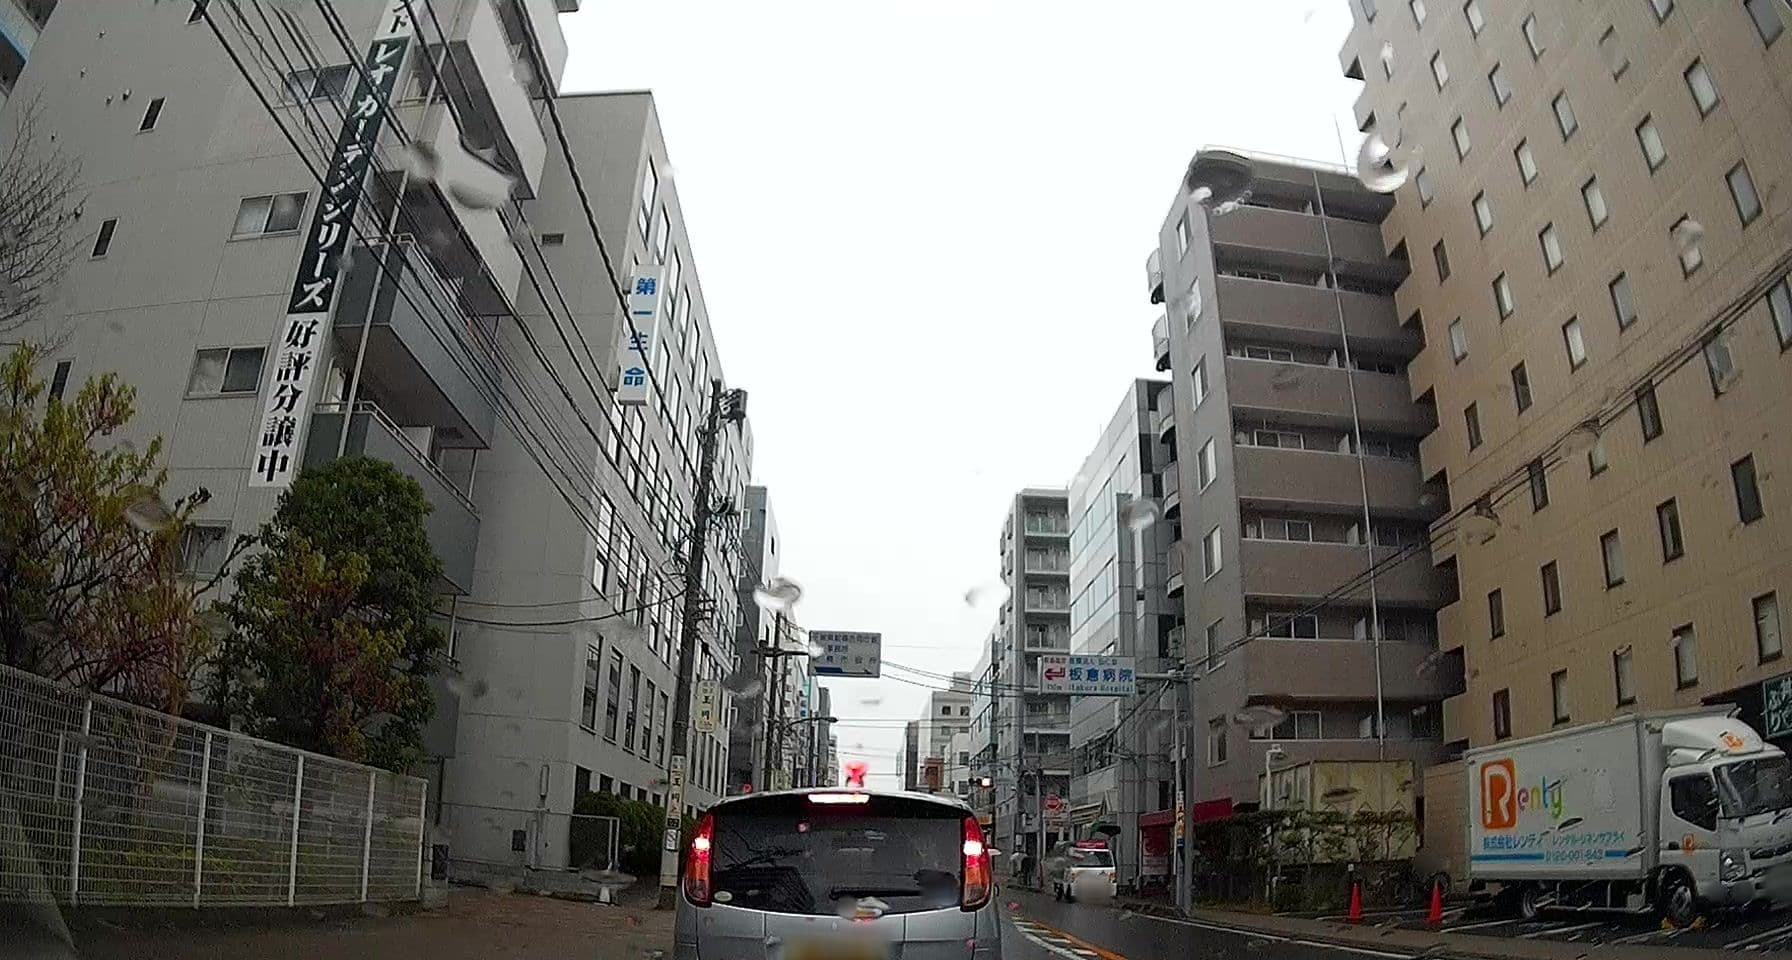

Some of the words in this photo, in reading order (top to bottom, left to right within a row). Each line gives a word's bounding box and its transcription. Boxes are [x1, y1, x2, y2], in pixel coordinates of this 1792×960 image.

[624, 277, 656, 387] 第一生命
[257, 318, 318, 483] 好評分譲中
[1069, 667, 1133, 682] 板倉病院
[1484, 764, 1562, 824] Renty
